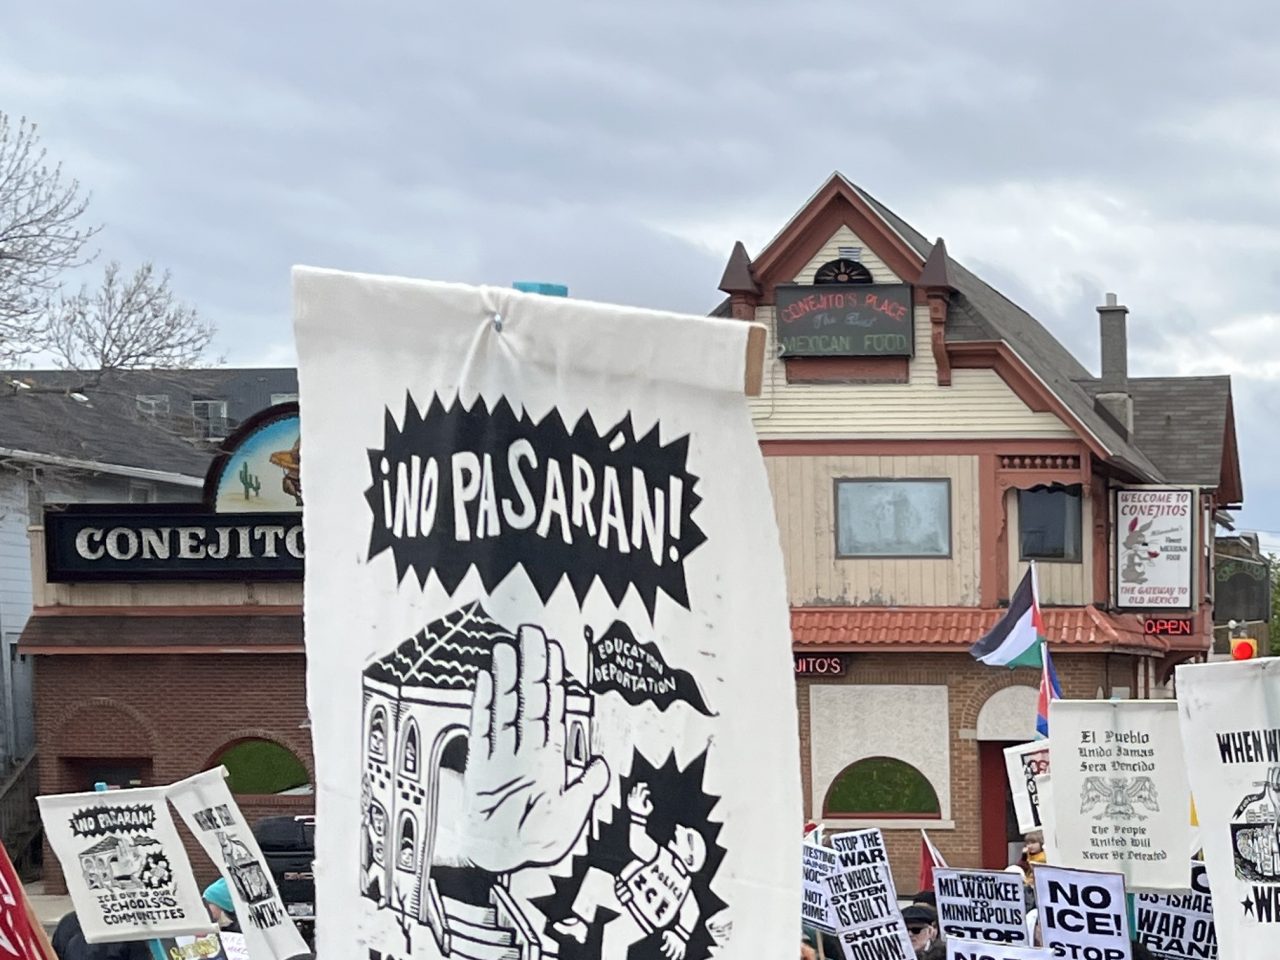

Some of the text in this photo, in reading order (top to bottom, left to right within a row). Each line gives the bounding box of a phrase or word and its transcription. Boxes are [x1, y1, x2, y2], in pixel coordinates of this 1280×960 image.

[865, 294, 907, 321] PLACE
[783, 334, 906, 351] MEXICAN FOOD
[381, 431, 684, 566] ¡NO PASARÁN!
[1121, 493, 1188, 503] WELCOME TO
[1121, 505, 1187, 517] CONEJITOS
[1121, 586, 1135, 594] THE
[1138, 586, 1174, 595] GATEWAY
[1129, 596, 1179, 604] OLD MEXICO
[1144, 620, 1191, 634] OPEN
[598, 641, 664, 675] EDUCATION
[615, 655, 644, 675] NOT
[594, 666, 677, 694] DEPORTATION
[1081, 730, 1150, 744] El Pueblo
[1216, 730, 1267, 763] WHEN
[1091, 825, 1147, 836] The People
[834, 832, 881, 851] STOP THE
[839, 849, 886, 868] WAR
[651, 864, 683, 901] POLICE
[826, 874, 847, 895] THE
[845, 866, 883, 892] WHOLE
[960, 874, 996, 883] FROM
[97, 894, 116, 903] ICE
[119, 891, 137, 899] OUT
[153, 889, 171, 897] OUR
[634, 873, 669, 921] ICE
[805, 889, 823, 905] NOT
[830, 884, 887, 905] SYSTEM
[938, 878, 1020, 902] MILWAUKEE
[1048, 881, 1112, 909] NO
[101, 897, 161, 914] SCHOOLS
[802, 902, 828, 923] RIME!
[836, 894, 891, 927] IS GUILTY
[972, 900, 989, 908] TO
[103, 908, 186, 926] COMMUNITIES
[941, 903, 1023, 926] MINNEAPOLIS
[1047, 906, 1122, 937] ICE!
[1138, 908, 1186, 939] WAR
[844, 921, 899, 944] SHUT IT
[943, 925, 1025, 944] STOP
